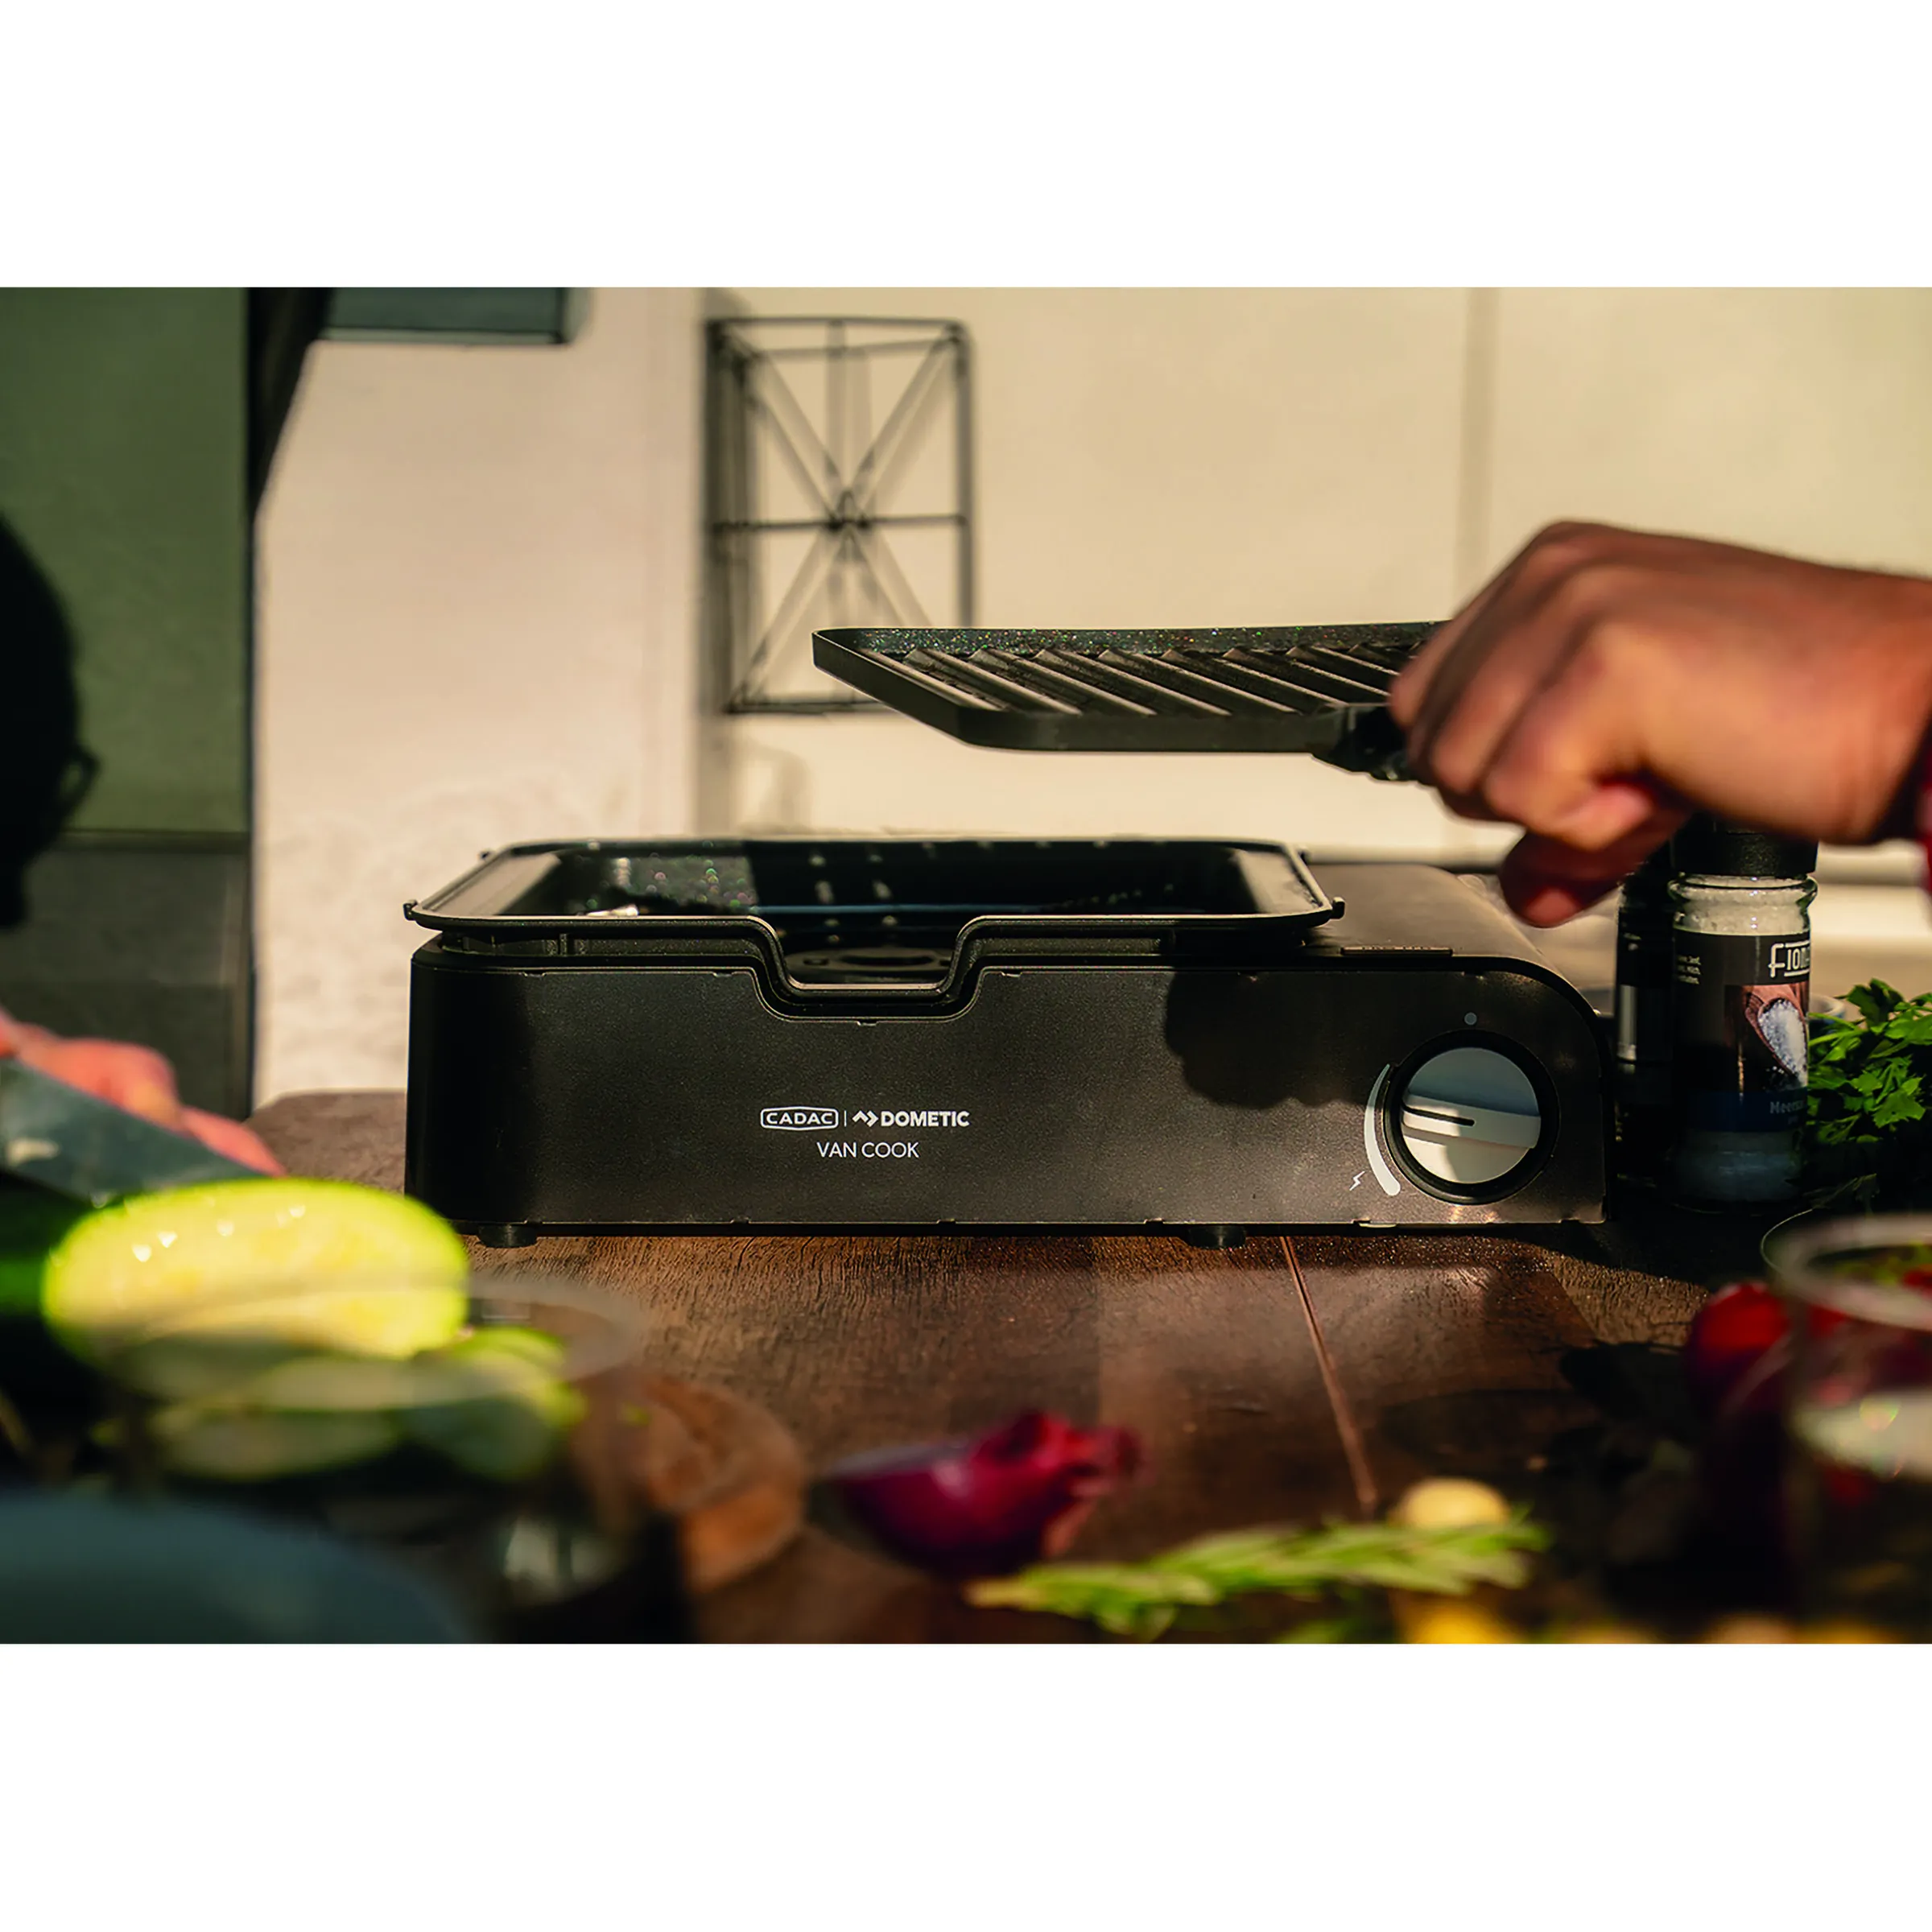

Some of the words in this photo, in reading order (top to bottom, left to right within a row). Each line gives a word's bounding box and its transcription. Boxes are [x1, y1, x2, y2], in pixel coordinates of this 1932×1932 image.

[766, 1111, 834, 1126] CADAC
[881, 1110, 970, 1127] DOMETIC
[816, 1141, 857, 1158] VAN
[861, 1141, 919, 1158] COOK
